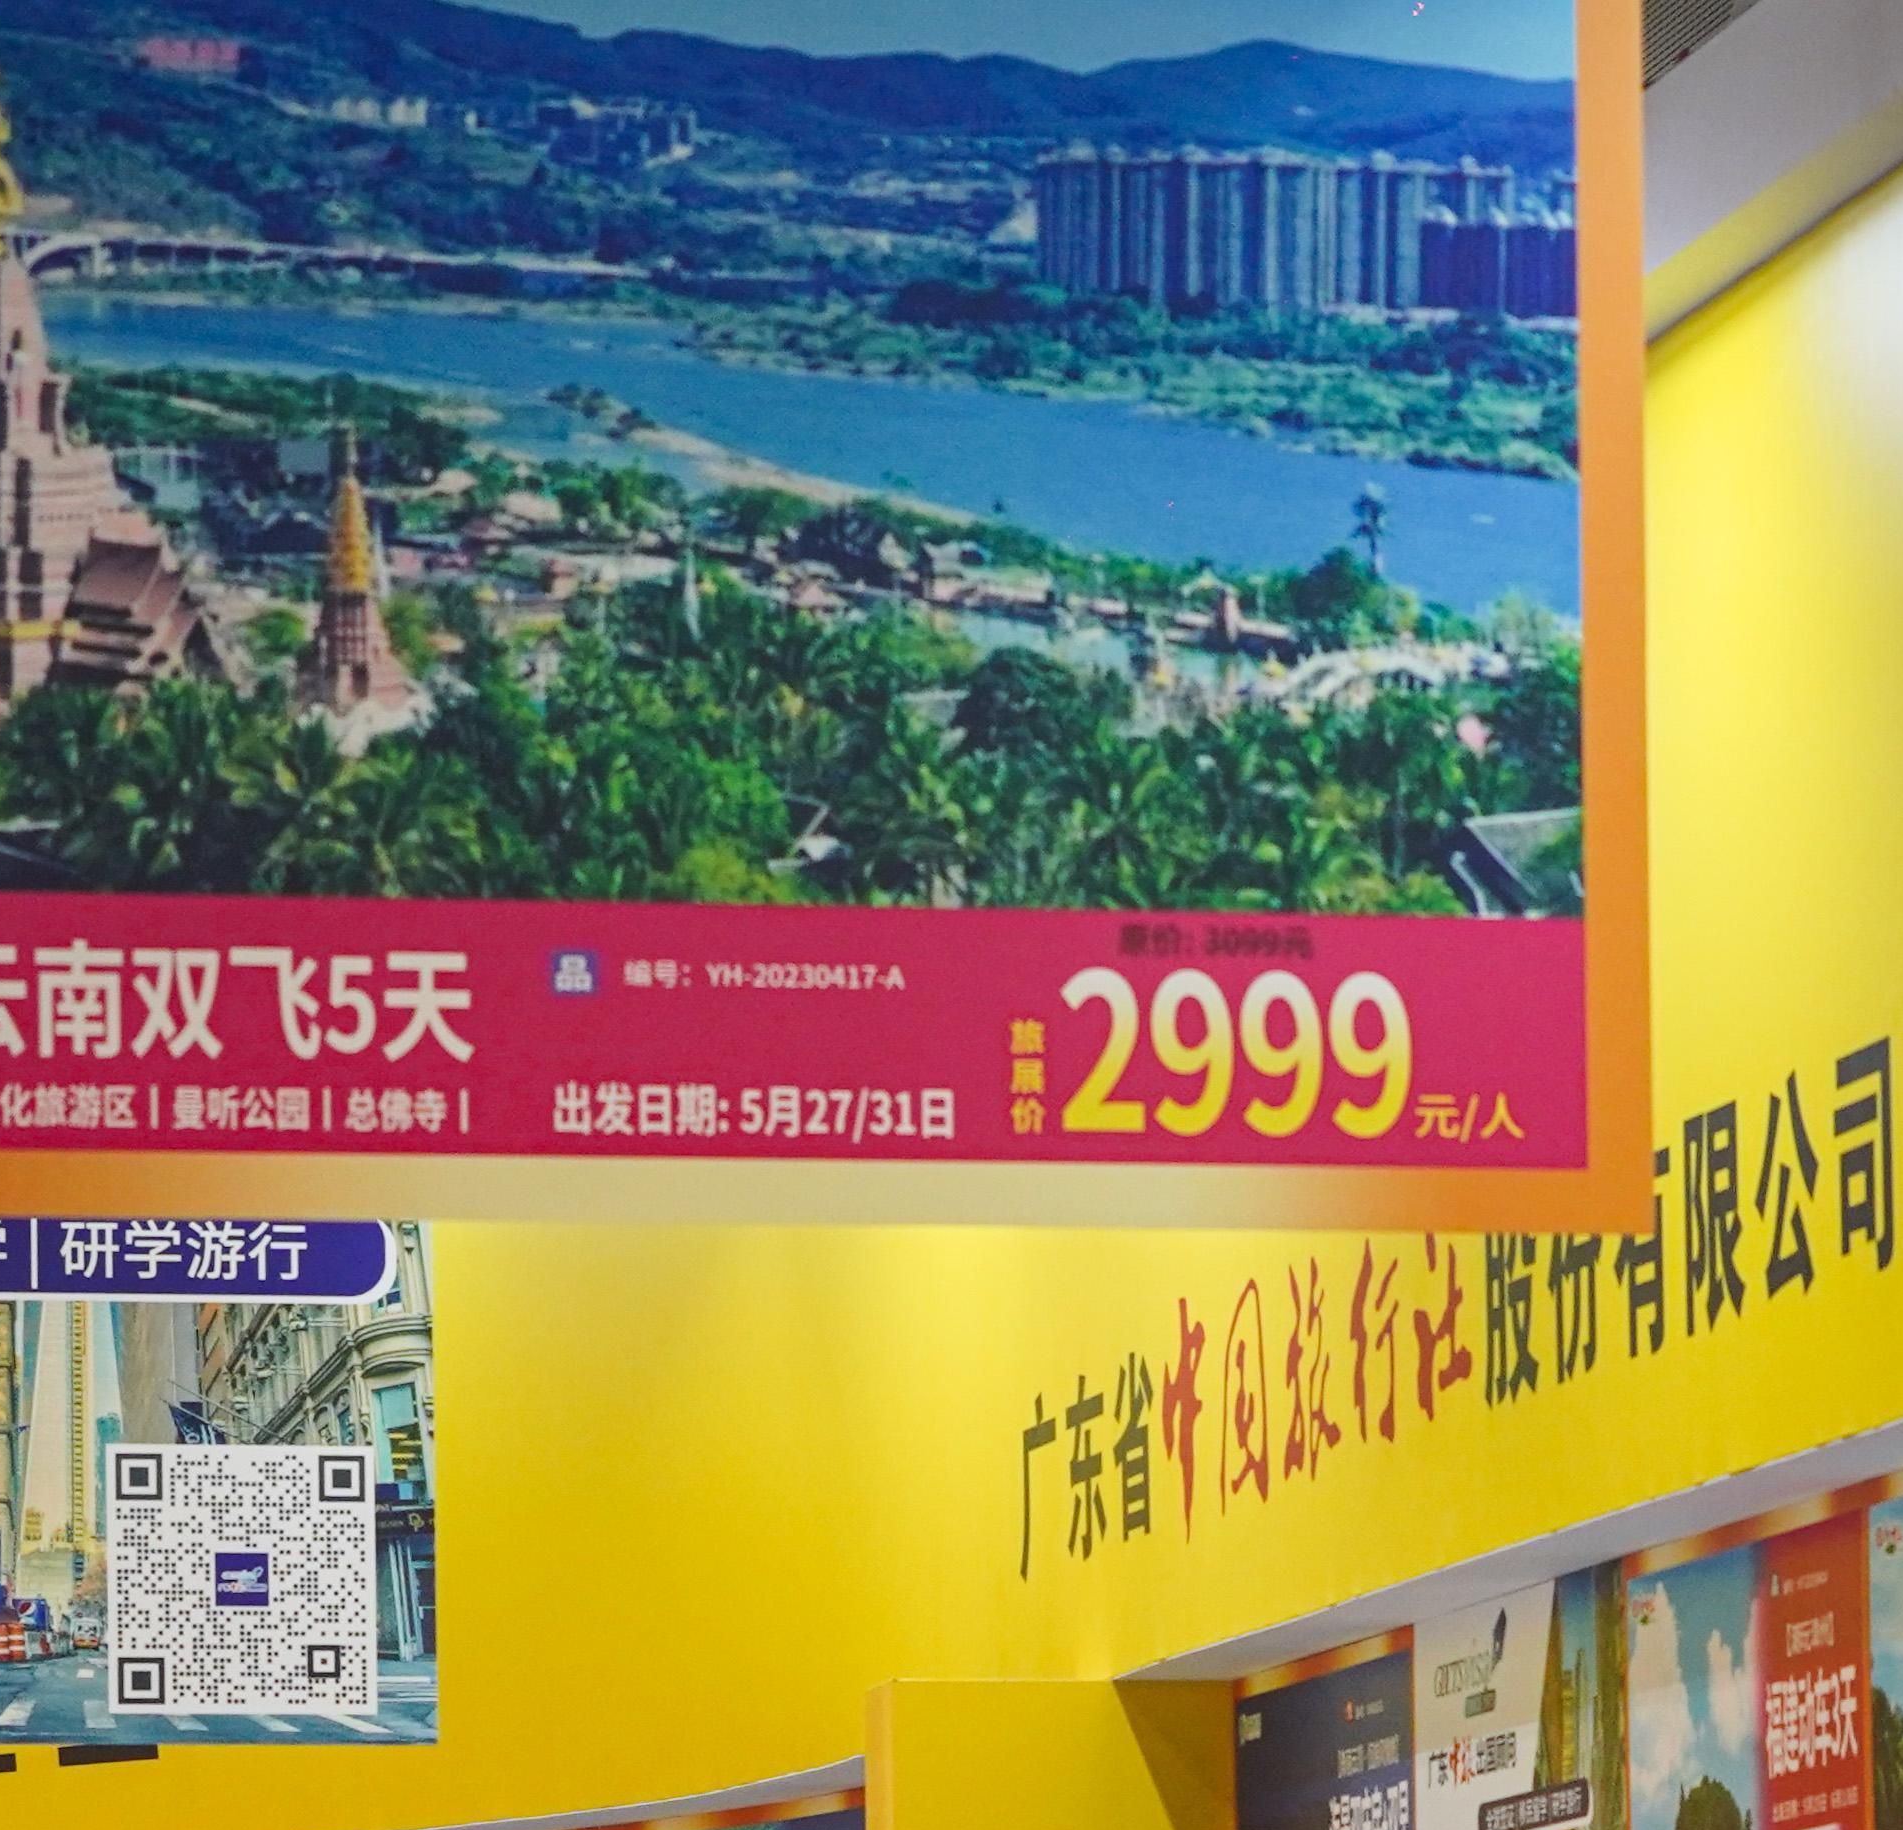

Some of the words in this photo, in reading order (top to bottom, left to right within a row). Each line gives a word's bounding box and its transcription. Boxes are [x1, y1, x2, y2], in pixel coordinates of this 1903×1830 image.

[172, 1087, 311, 1131] 曼听公园
[344, 1089, 449, 1133] 总佛寺
[1009, 1017, 1046, 1136] 旅展价
[1059, 967, 1414, 1140] 2999
[1414, 1092, 1525, 1143] 元/人
[59, 1221, 308, 1282] 研学游行
[1017, 1036, 1895, 1583] 广东省中国旅行社股份有限公司
